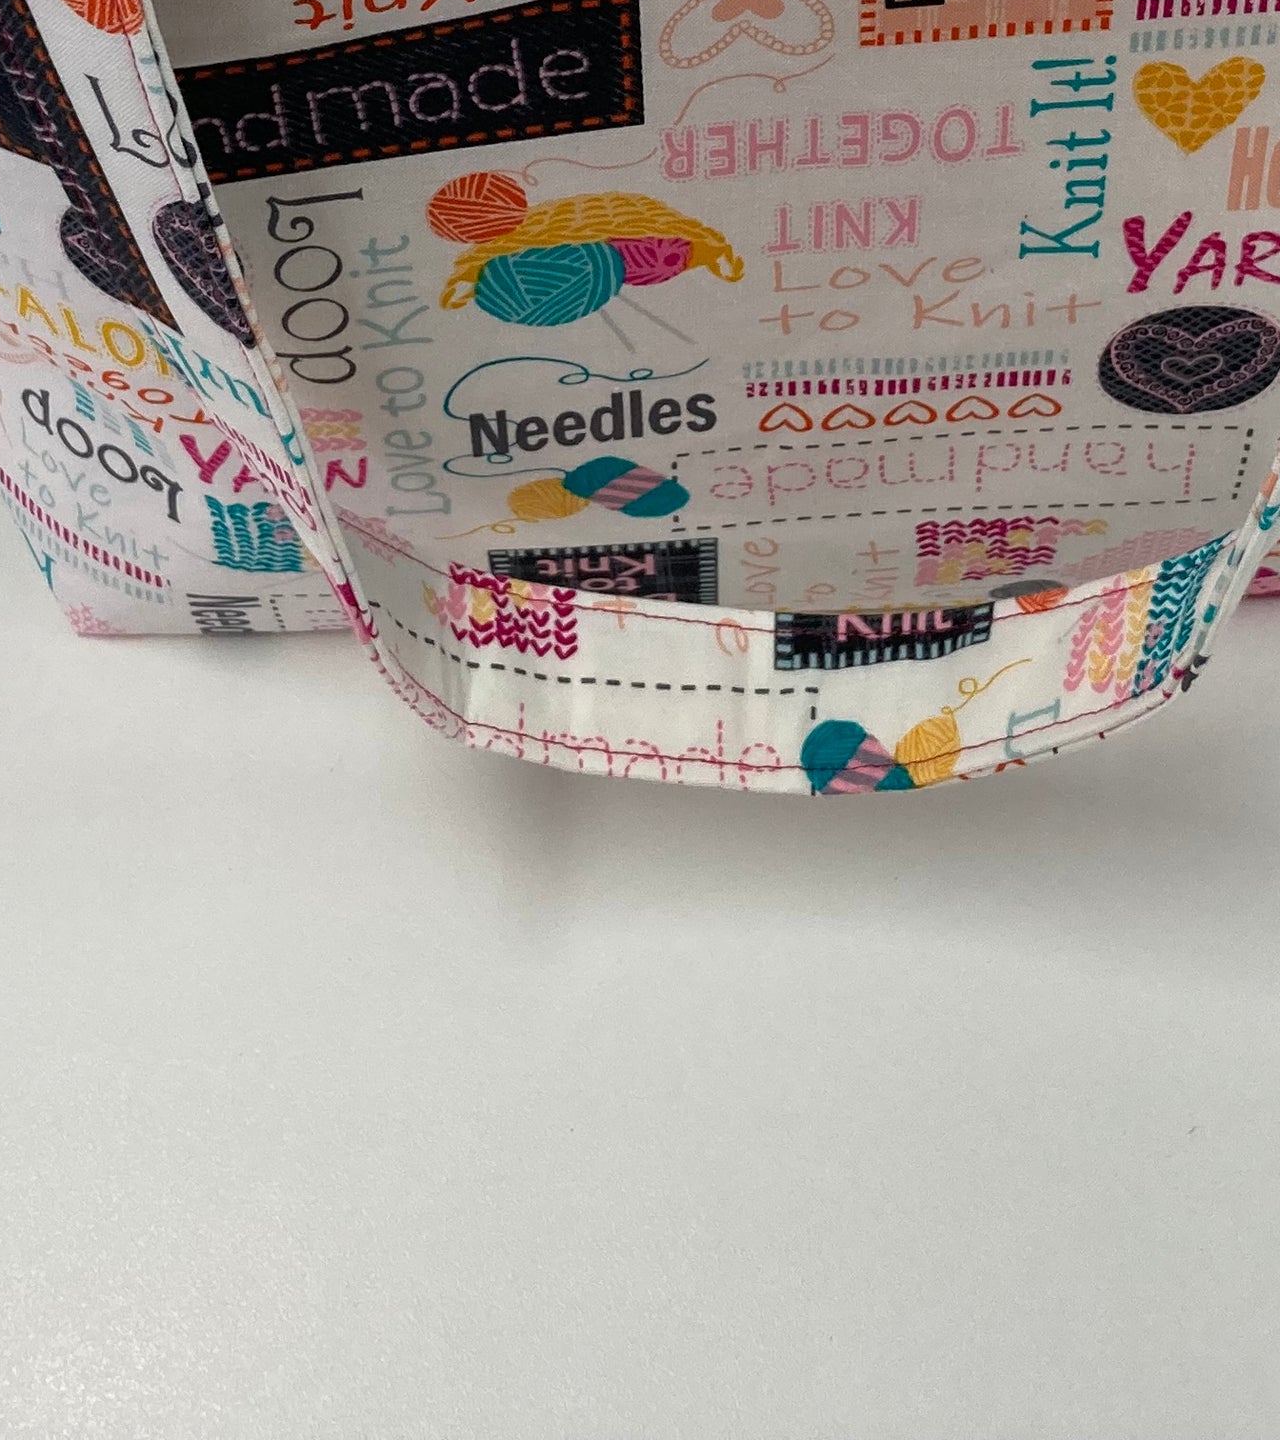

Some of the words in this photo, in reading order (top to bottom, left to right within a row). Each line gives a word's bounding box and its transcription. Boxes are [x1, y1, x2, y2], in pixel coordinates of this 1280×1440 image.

[1030, 55, 1117, 117] It!
[661, 103, 1024, 182] TOGETHER
[763, 195, 920, 256] KNIT
[1019, 129, 1111, 259] Knit
[266, 187, 365, 384] Loop
[351, 233, 433, 350] Knit
[773, 256, 986, 293] Love
[759, 304, 861, 336] to
[914, 289, 1102, 330] Knit
[375, 366, 428, 418] to
[469, 390, 718, 459] Needles
[20, 416, 111, 507] Love
[22, 389, 183, 523] Loop
[385, 426, 453, 517] Love
[709, 440, 1196, 507] handmade
[19, 460, 56, 508] to
[77, 502, 170, 570] Knit
[538, 552, 656, 580] Knit
